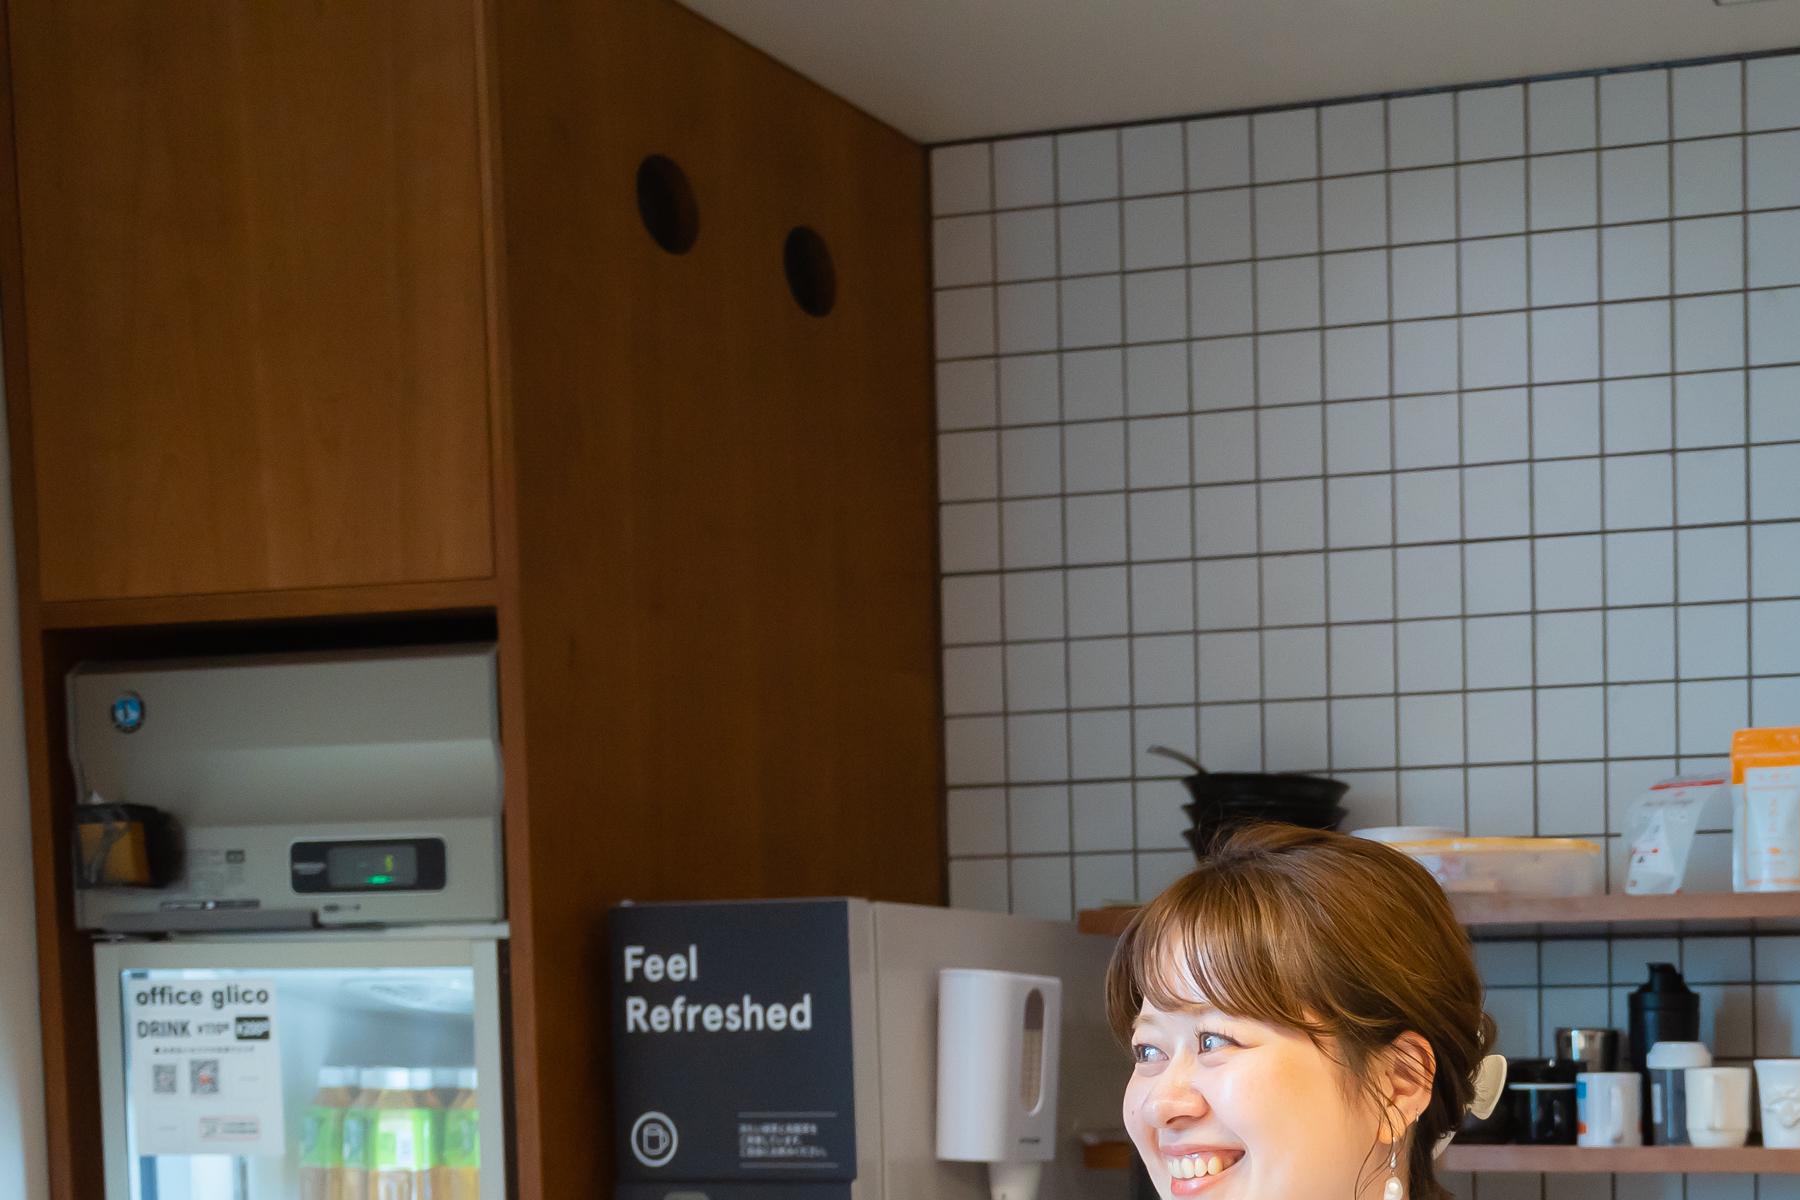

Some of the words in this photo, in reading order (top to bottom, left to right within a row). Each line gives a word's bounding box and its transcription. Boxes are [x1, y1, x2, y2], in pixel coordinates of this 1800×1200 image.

[624, 943, 699, 983] Feel
[136, 984, 203, 1006] office
[211, 984, 270, 1010] glico
[625, 993, 813, 1033] Refreshed
[137, 1020, 192, 1039] DRINK
